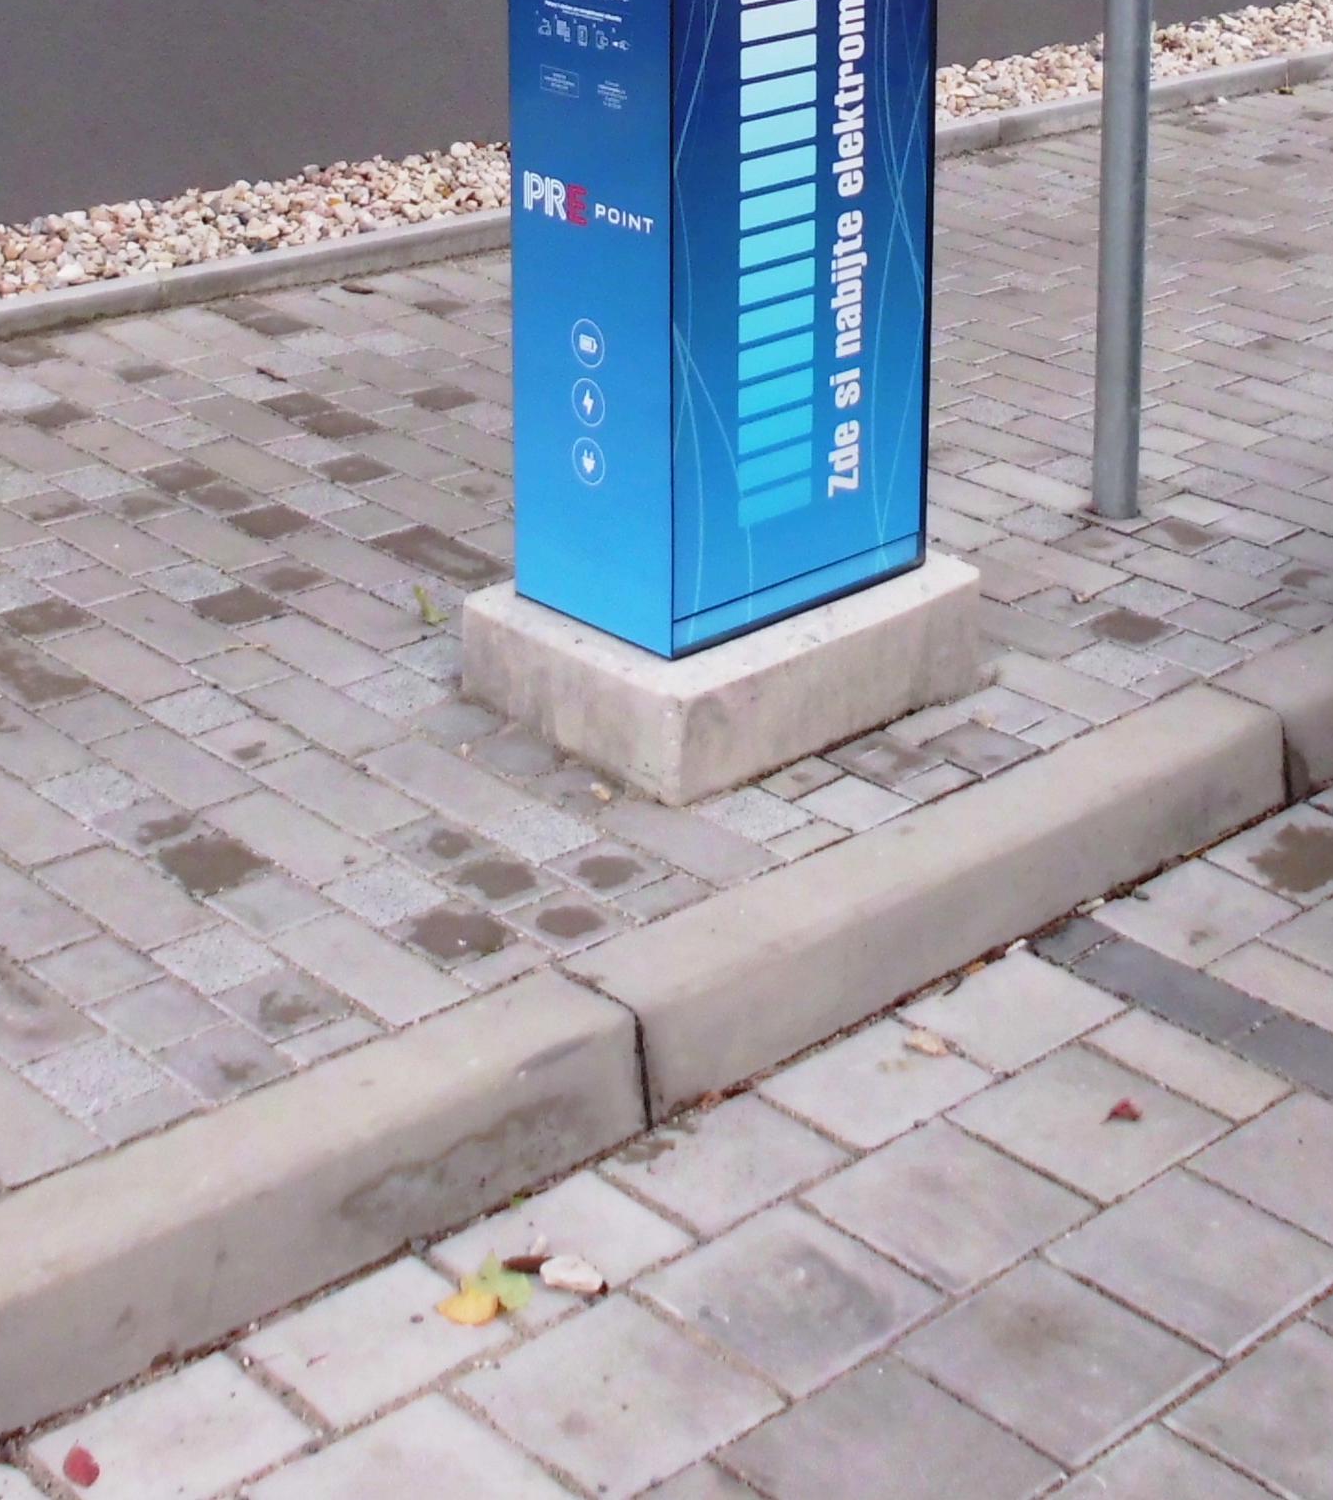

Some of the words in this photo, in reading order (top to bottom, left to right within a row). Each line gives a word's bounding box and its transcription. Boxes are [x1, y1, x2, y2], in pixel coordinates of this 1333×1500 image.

[523, 170, 589, 227] PRE
[594, 202, 654, 234] POINT
[830, 210, 868, 357] nabijte
[830, 367, 861, 409] si
[828, 418, 860, 498] Zde
